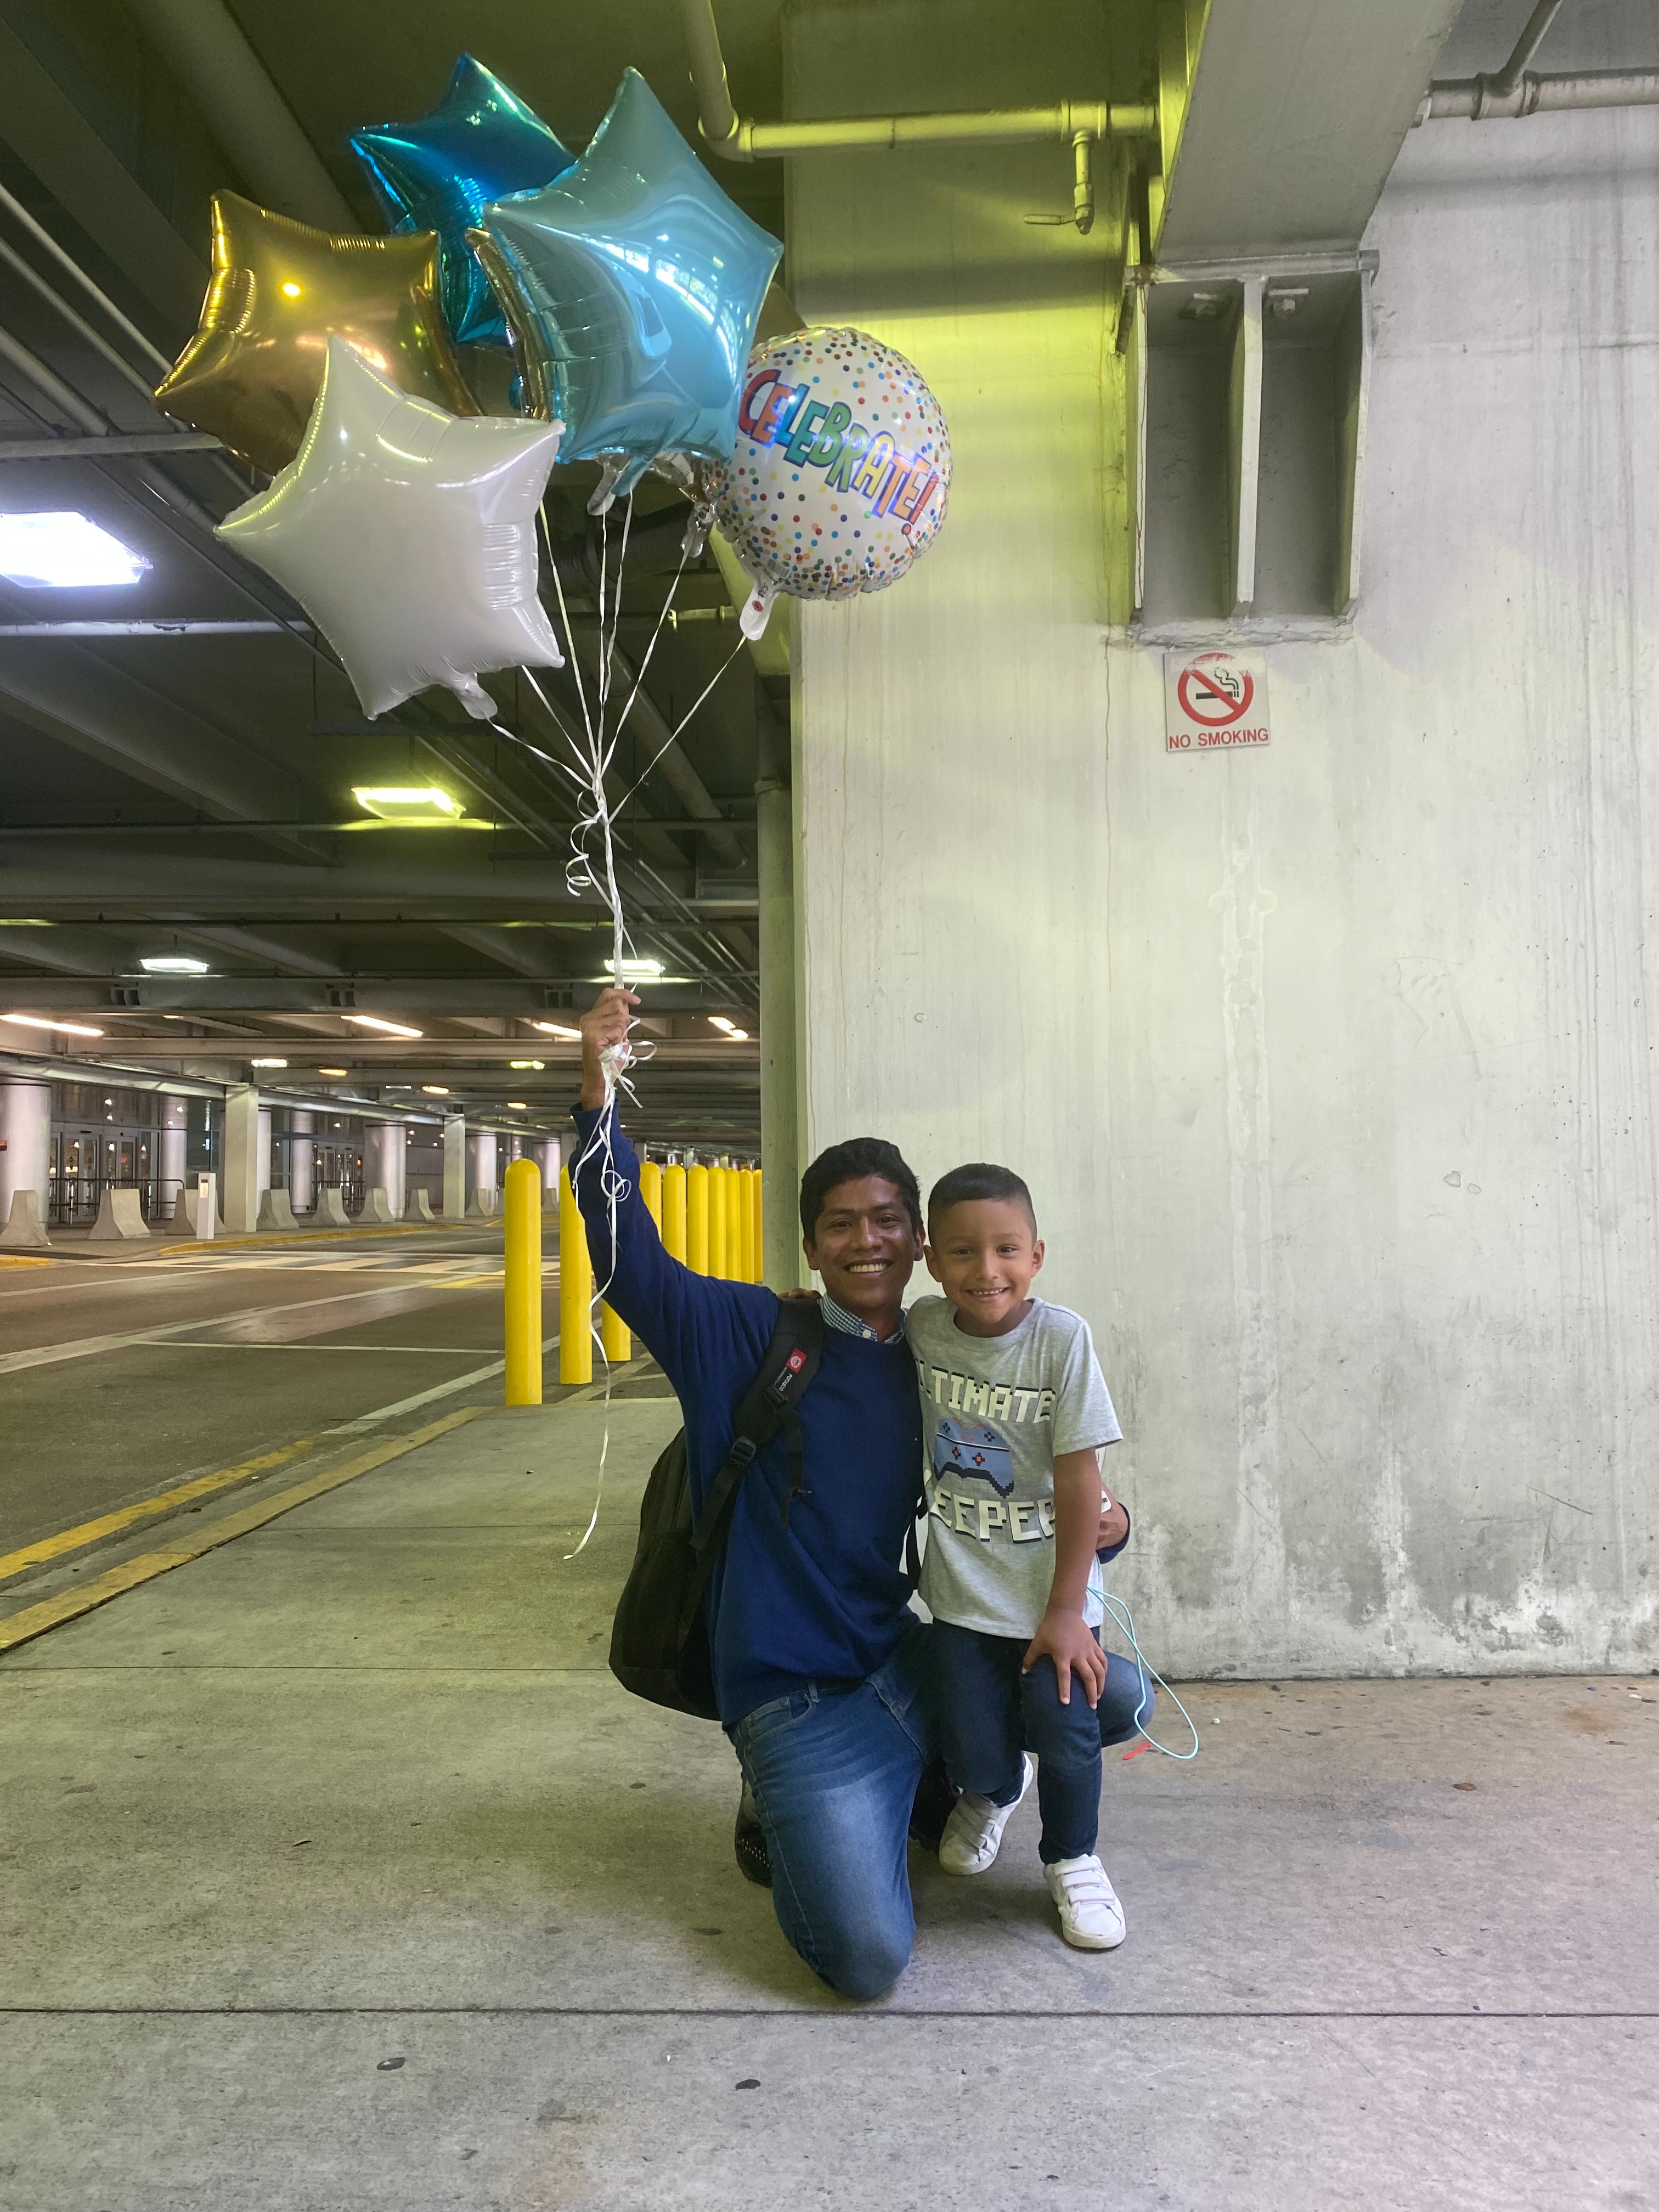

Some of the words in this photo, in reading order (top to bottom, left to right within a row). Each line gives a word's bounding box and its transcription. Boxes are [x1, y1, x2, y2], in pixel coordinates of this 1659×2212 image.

[737, 369, 939, 535] CELEBRATE!
[1169, 733, 1191, 749] NO
[1198, 727, 1269, 747] SMOKING
